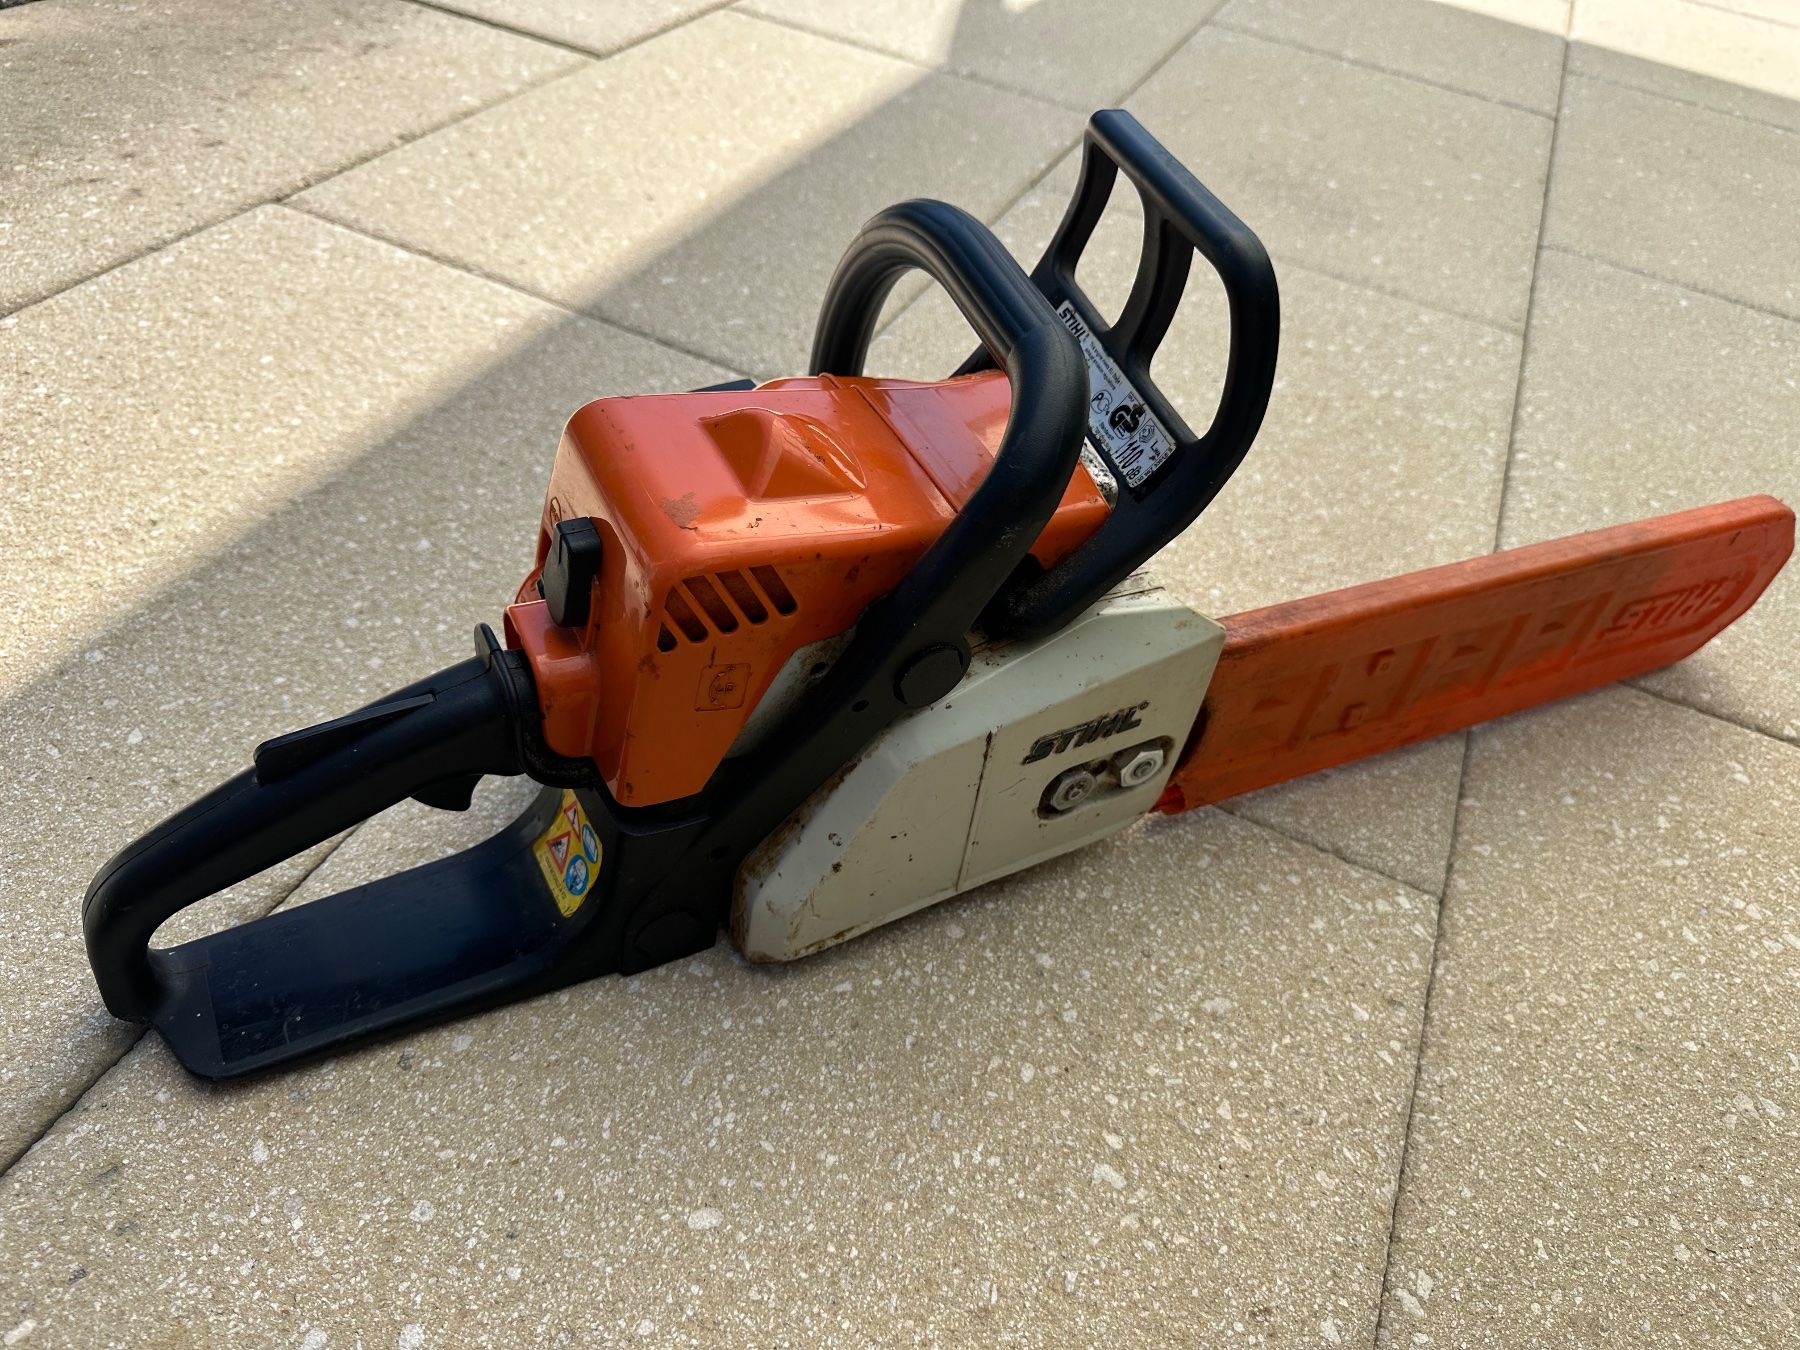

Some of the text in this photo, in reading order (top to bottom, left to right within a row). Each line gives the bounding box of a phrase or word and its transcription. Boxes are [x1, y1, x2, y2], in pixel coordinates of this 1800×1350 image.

[1059, 307, 1086, 343] STIHL
[1109, 404, 1146, 434] GS
[1115, 440, 1144, 470] 110
[1596, 576, 1729, 639] STIHL
[1020, 703, 1143, 765] STIHL
